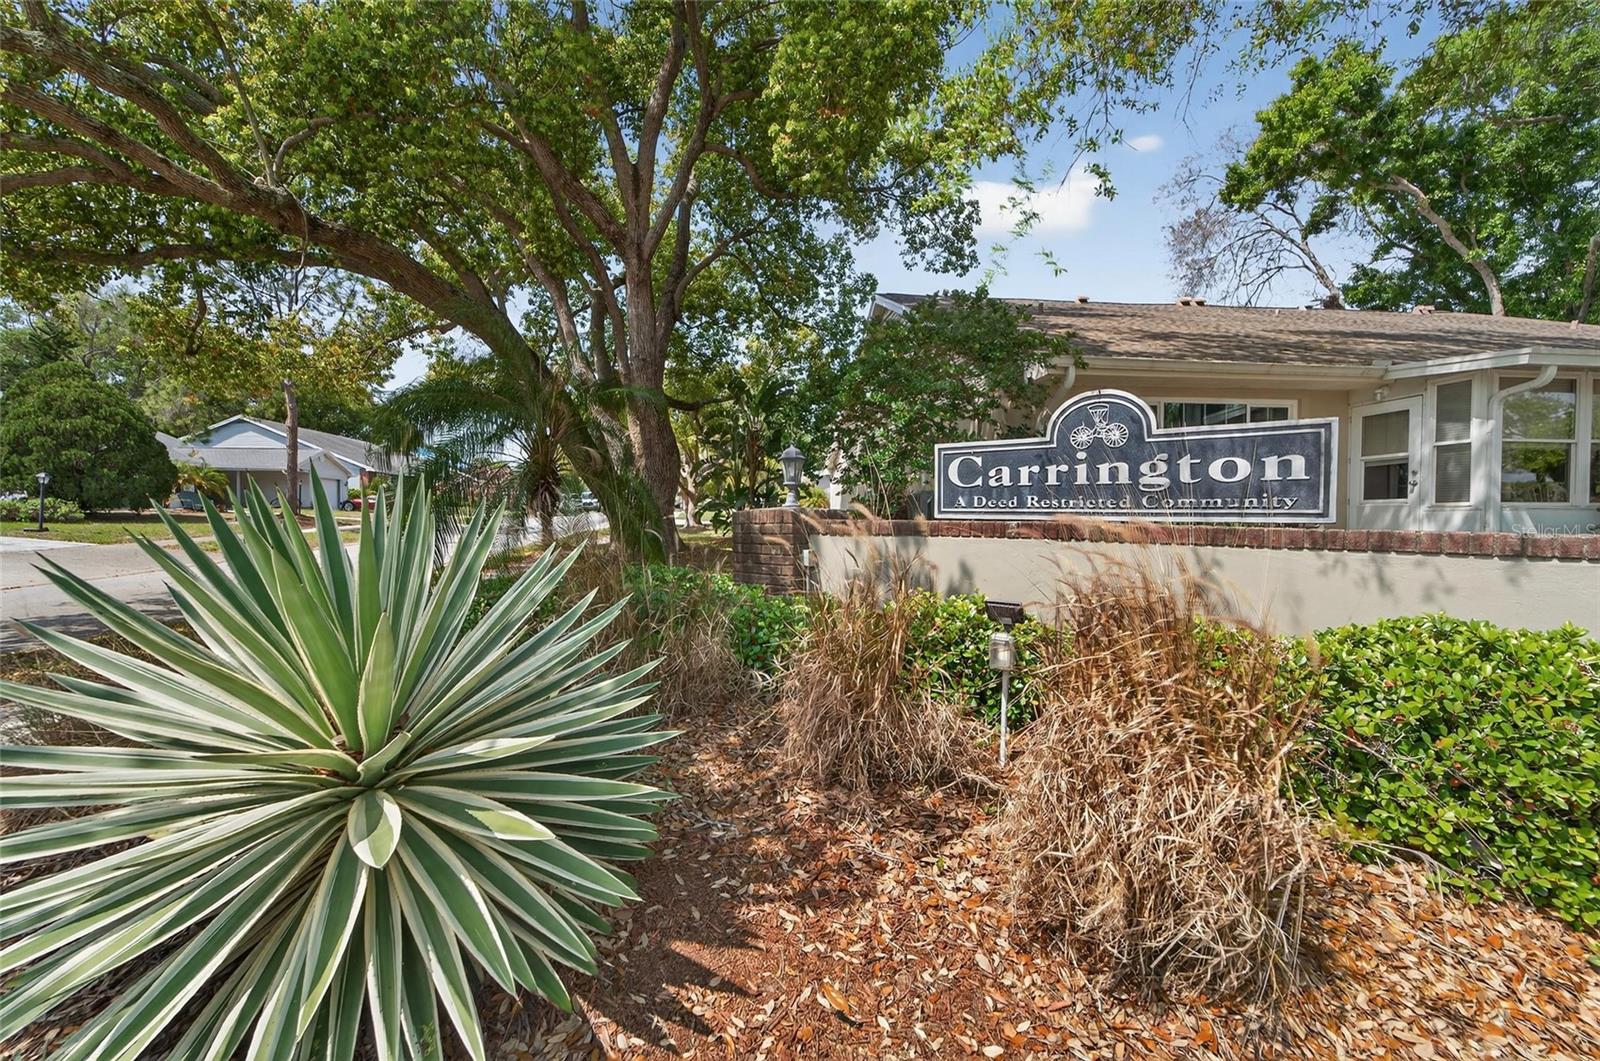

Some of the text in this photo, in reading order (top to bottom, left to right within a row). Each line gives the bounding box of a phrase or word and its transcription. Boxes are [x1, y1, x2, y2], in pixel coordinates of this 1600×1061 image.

[947, 452, 1310, 492] Carrington
[954, 492, 1299, 510] A Deed Restricted Community
